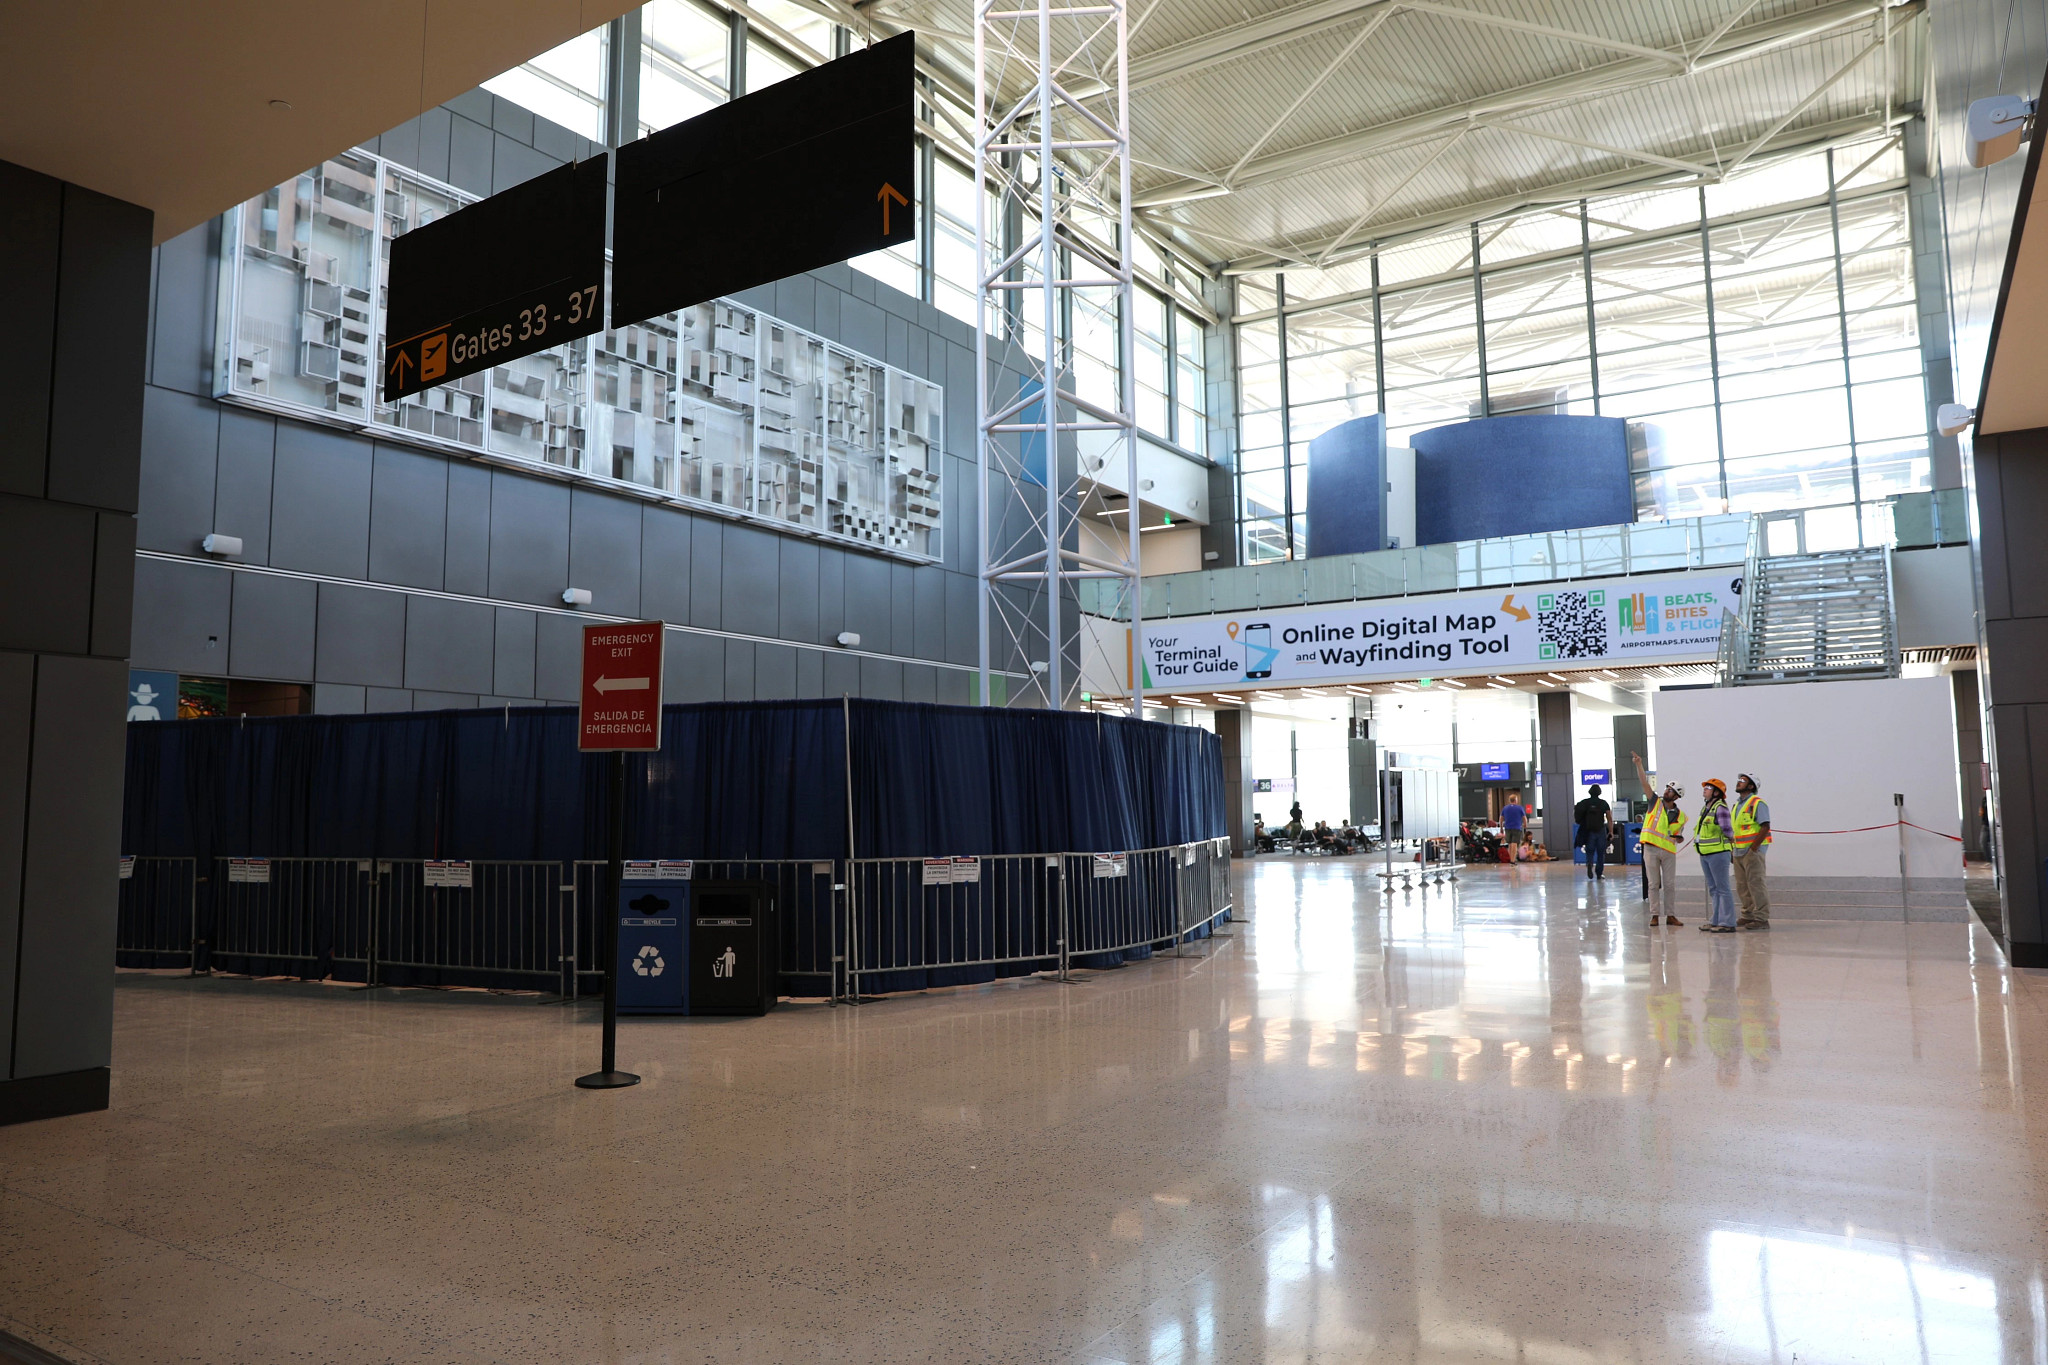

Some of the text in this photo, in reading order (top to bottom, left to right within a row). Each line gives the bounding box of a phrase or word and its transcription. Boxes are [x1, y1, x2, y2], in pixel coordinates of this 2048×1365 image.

[451, 285, 598, 364] Gates 33 - 37
[1664, 592, 1718, 606] BEATS,
[1665, 606, 1708, 619] BITES
[1282, 613, 1496, 644] Online Digital Map
[1665, 618, 1723, 632] & FLIGH
[592, 633, 654, 646] EMERGENCY
[1149, 636, 1178, 648] Your
[611, 647, 633, 658] EXIT
[1155, 645, 1221, 662] Terminal
[1295, 634, 1509, 666] and Wayfinding Tool
[1155, 659, 1239, 676] Tour Guide
[594, 711, 645, 721] SALIDA DE
[586, 723, 652, 734] EMERGENCIA
[1584, 773, 1604, 782] porter
[1260, 781, 1271, 790] 36
